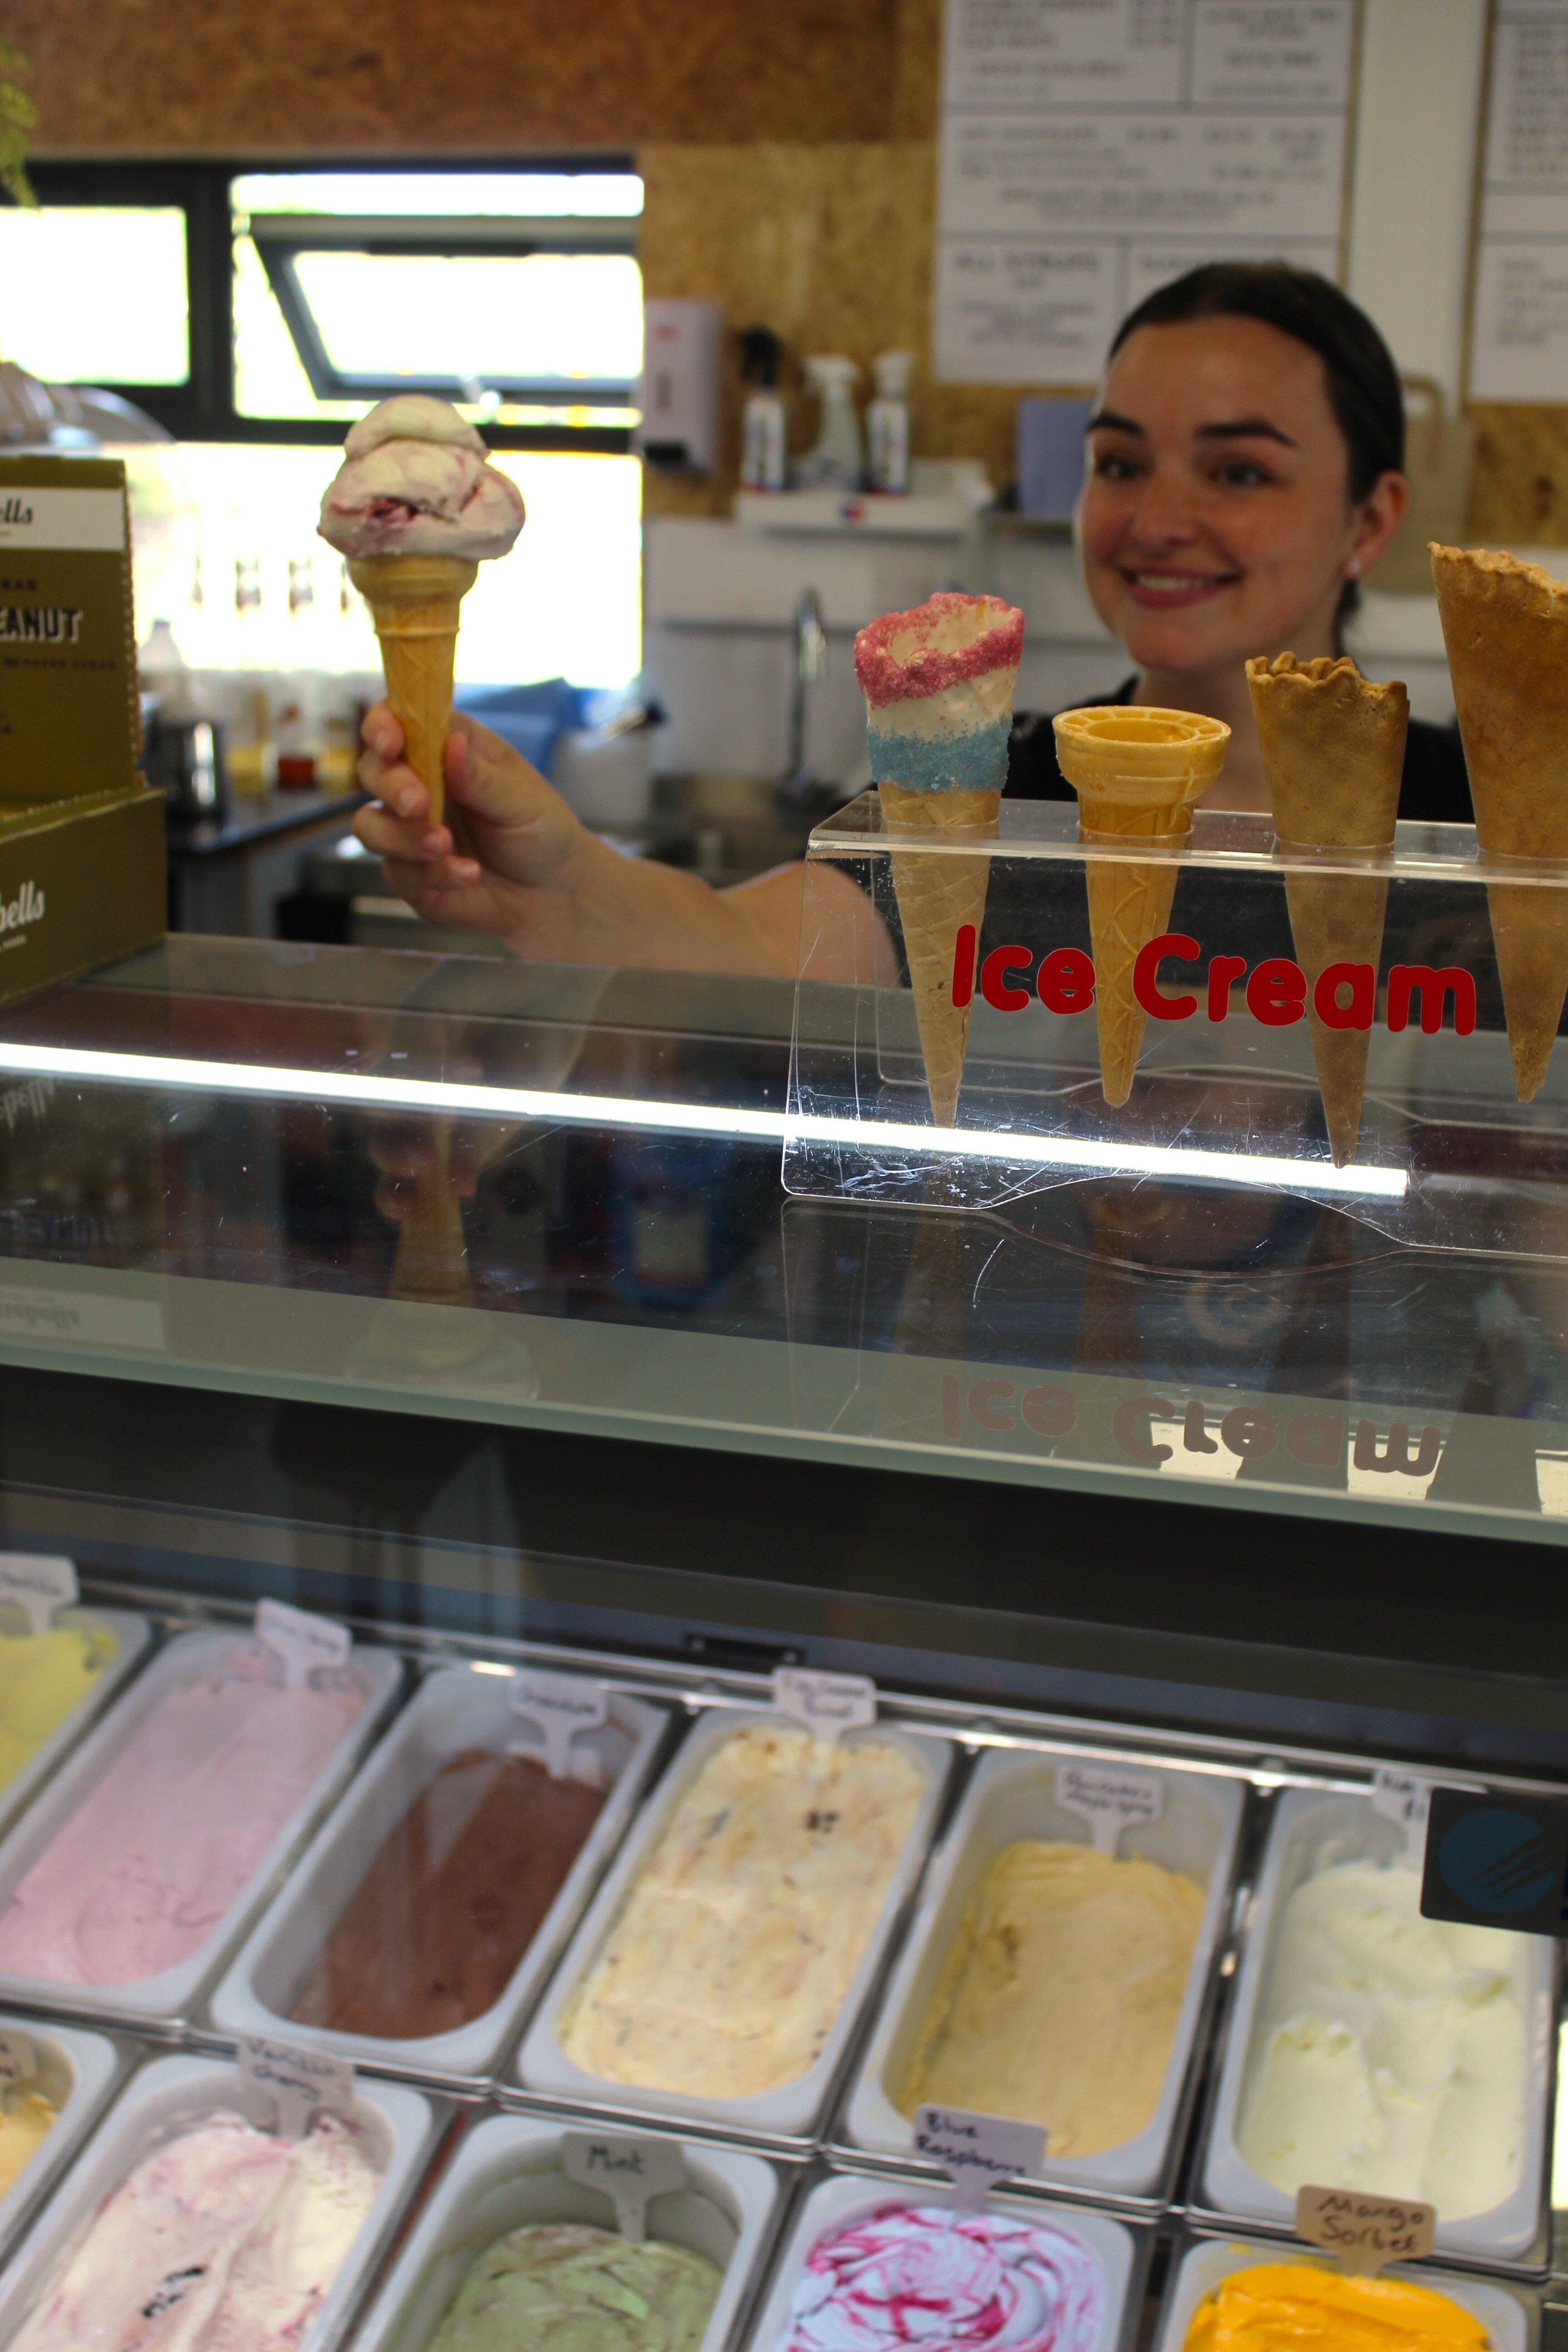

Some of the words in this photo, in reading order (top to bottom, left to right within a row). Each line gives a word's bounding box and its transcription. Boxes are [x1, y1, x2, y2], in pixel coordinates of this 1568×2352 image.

[952, 924, 1096, 1014] Ice
[1133, 934, 1476, 1035] Cream
[926, 2111, 978, 2139] Blue
[588, 2145, 645, 2175] Mint
[1317, 2195, 1426, 2232] Mango
[1321, 2214, 1416, 2252] Sorbet
